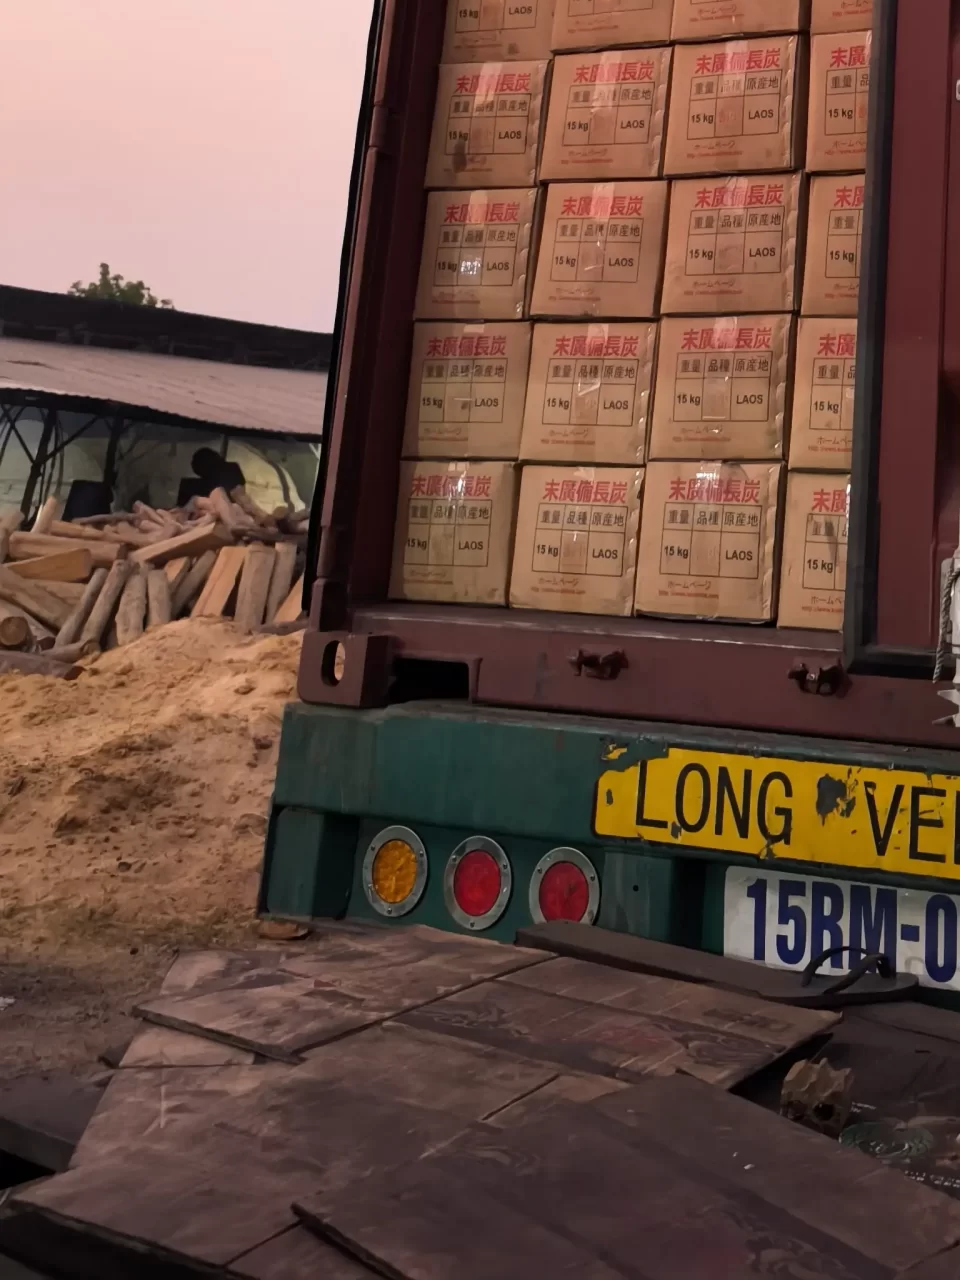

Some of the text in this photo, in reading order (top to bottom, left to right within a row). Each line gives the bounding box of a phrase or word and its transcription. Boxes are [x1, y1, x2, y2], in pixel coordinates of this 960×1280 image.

[508, 6, 532, 15] LAOS
[691, 113, 714, 124] 15 kg
[748, 109, 774, 120] LAOS
[828, 108, 853, 120] 15 kg
[567, 121, 588, 132] 15 kg
[620, 120, 645, 130] LAOS
[498, 130, 522, 140] LAOS
[688, 248, 714, 260] 15 kg
[749, 247, 776, 258] LAOS
[829, 250, 854, 263] 15 kg
[486, 262, 510, 271] LAOS
[554, 256, 576, 268] 15 kg
[608, 258, 634, 267] LAOS
[474, 398, 499, 408] LAOS
[546, 398, 570, 410] 15 kg
[676, 394, 701, 406] 15 kg
[736, 394, 763, 404] LAOS
[603, 400, 629, 410] LAOS
[814, 400, 839, 414] 15 kg
[458, 541, 484, 550] LAOS
[536, 544, 558, 558] 15 kg
[592, 548, 618, 560] LAOS
[664, 545, 689, 559] 15 kg
[725, 550, 753, 561] LAOS
[806, 559, 834, 574] 15 kg
[636, 760, 793, 845] LONG
